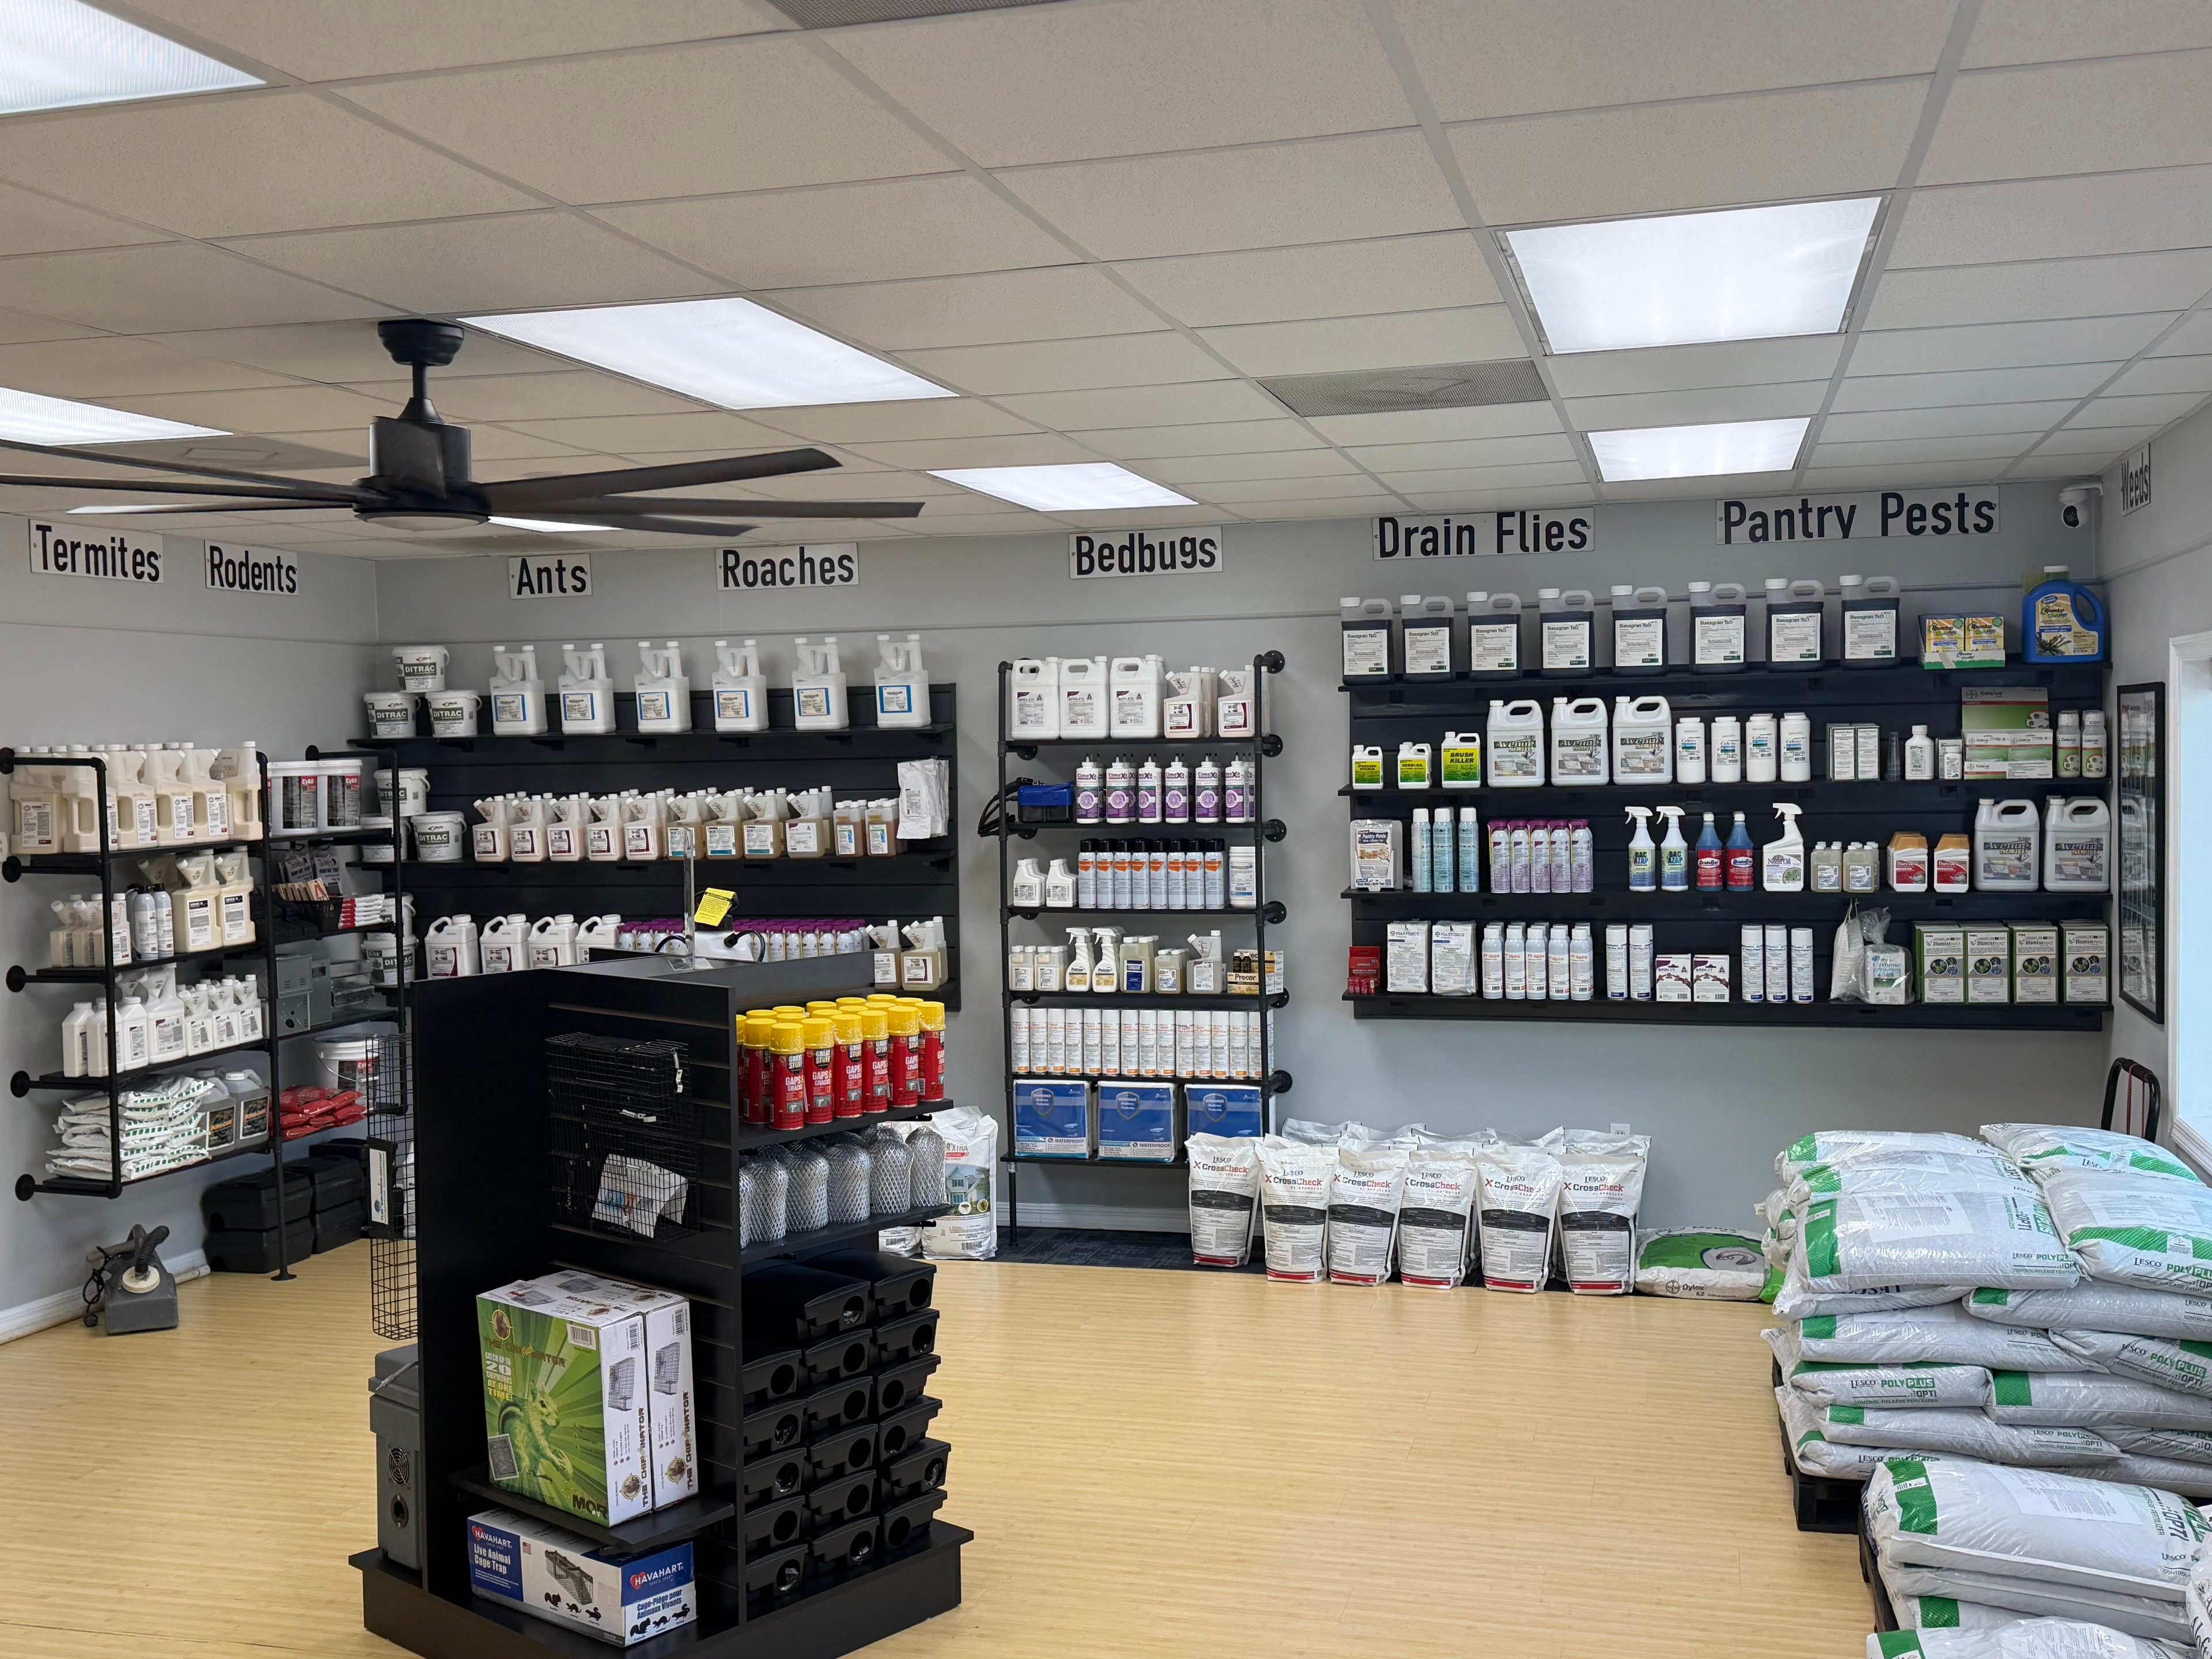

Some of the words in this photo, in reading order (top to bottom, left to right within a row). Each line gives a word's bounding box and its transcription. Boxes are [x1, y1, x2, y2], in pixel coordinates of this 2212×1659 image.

[2122, 452, 2150, 512] Weeds
[1724, 500, 1857, 544] Pantry
[1881, 493, 1995, 536] Pests
[1379, 517, 1475, 558] Drain
[1498, 512, 1588, 554] Flies
[36, 525, 161, 582] Termites
[1075, 533, 1217, 575] Bedbugs
[210, 546, 297, 593] Rodents
[722, 546, 854, 588] Roaches
[517, 558, 586, 595] Ants
[405, 665, 435, 673] DITRAC
[385, 956, 412, 966] DITAC
[846, 1065, 859, 1074] GAPS
[873, 1061, 886, 1070] GAPS
[786, 1076, 801, 1086] GAPS
[813, 1071, 828, 1080] GAPS
[1202, 1164, 1248, 1173] CrossCheck
[1274, 1177, 1322, 1186] CrossCheck
[1342, 1177, 1392, 1188] CrossCheck
[1410, 1179, 1461, 1190] CrossCheck
[1573, 1184, 1624, 1192] CrossCheck
[2134, 1258, 2161, 1267] LESCO
[485, 1352, 498, 1362] CATCH
[505, 1357, 511, 1365] TO
[2122, 1343, 2146, 1355] LESCO
[2177, 1361, 2205, 1376] PLUS
[486, 1361, 511, 1376] 20
[486, 1370, 512, 1385] CHIPMUNKS
[1851, 1379, 1876, 1388] LESCO
[2181, 1374, 2202, 1386] OPTI
[488, 1380, 497, 1388] AT
[499, 1382, 513, 1393] ONE
[488, 1388, 513, 1402] TIME!
[2162, 1510, 2189, 1541] OPTI
[475, 1530, 512, 1548] HAVAHART
[474, 1543, 486, 1557] Live
[488, 1549, 510, 1566] Animal
[2162, 1553, 2185, 1561] LESCO
[475, 1555, 491, 1569] Cage
[492, 1562, 507, 1575] Trap
[635, 1562, 683, 1586] HAVAHART
[637, 1594, 668, 1611] Cage-Piège
[669, 1589, 682, 1600] pour
[637, 1605, 661, 1620] Animaux
[661, 1597, 682, 1610] Vivants
